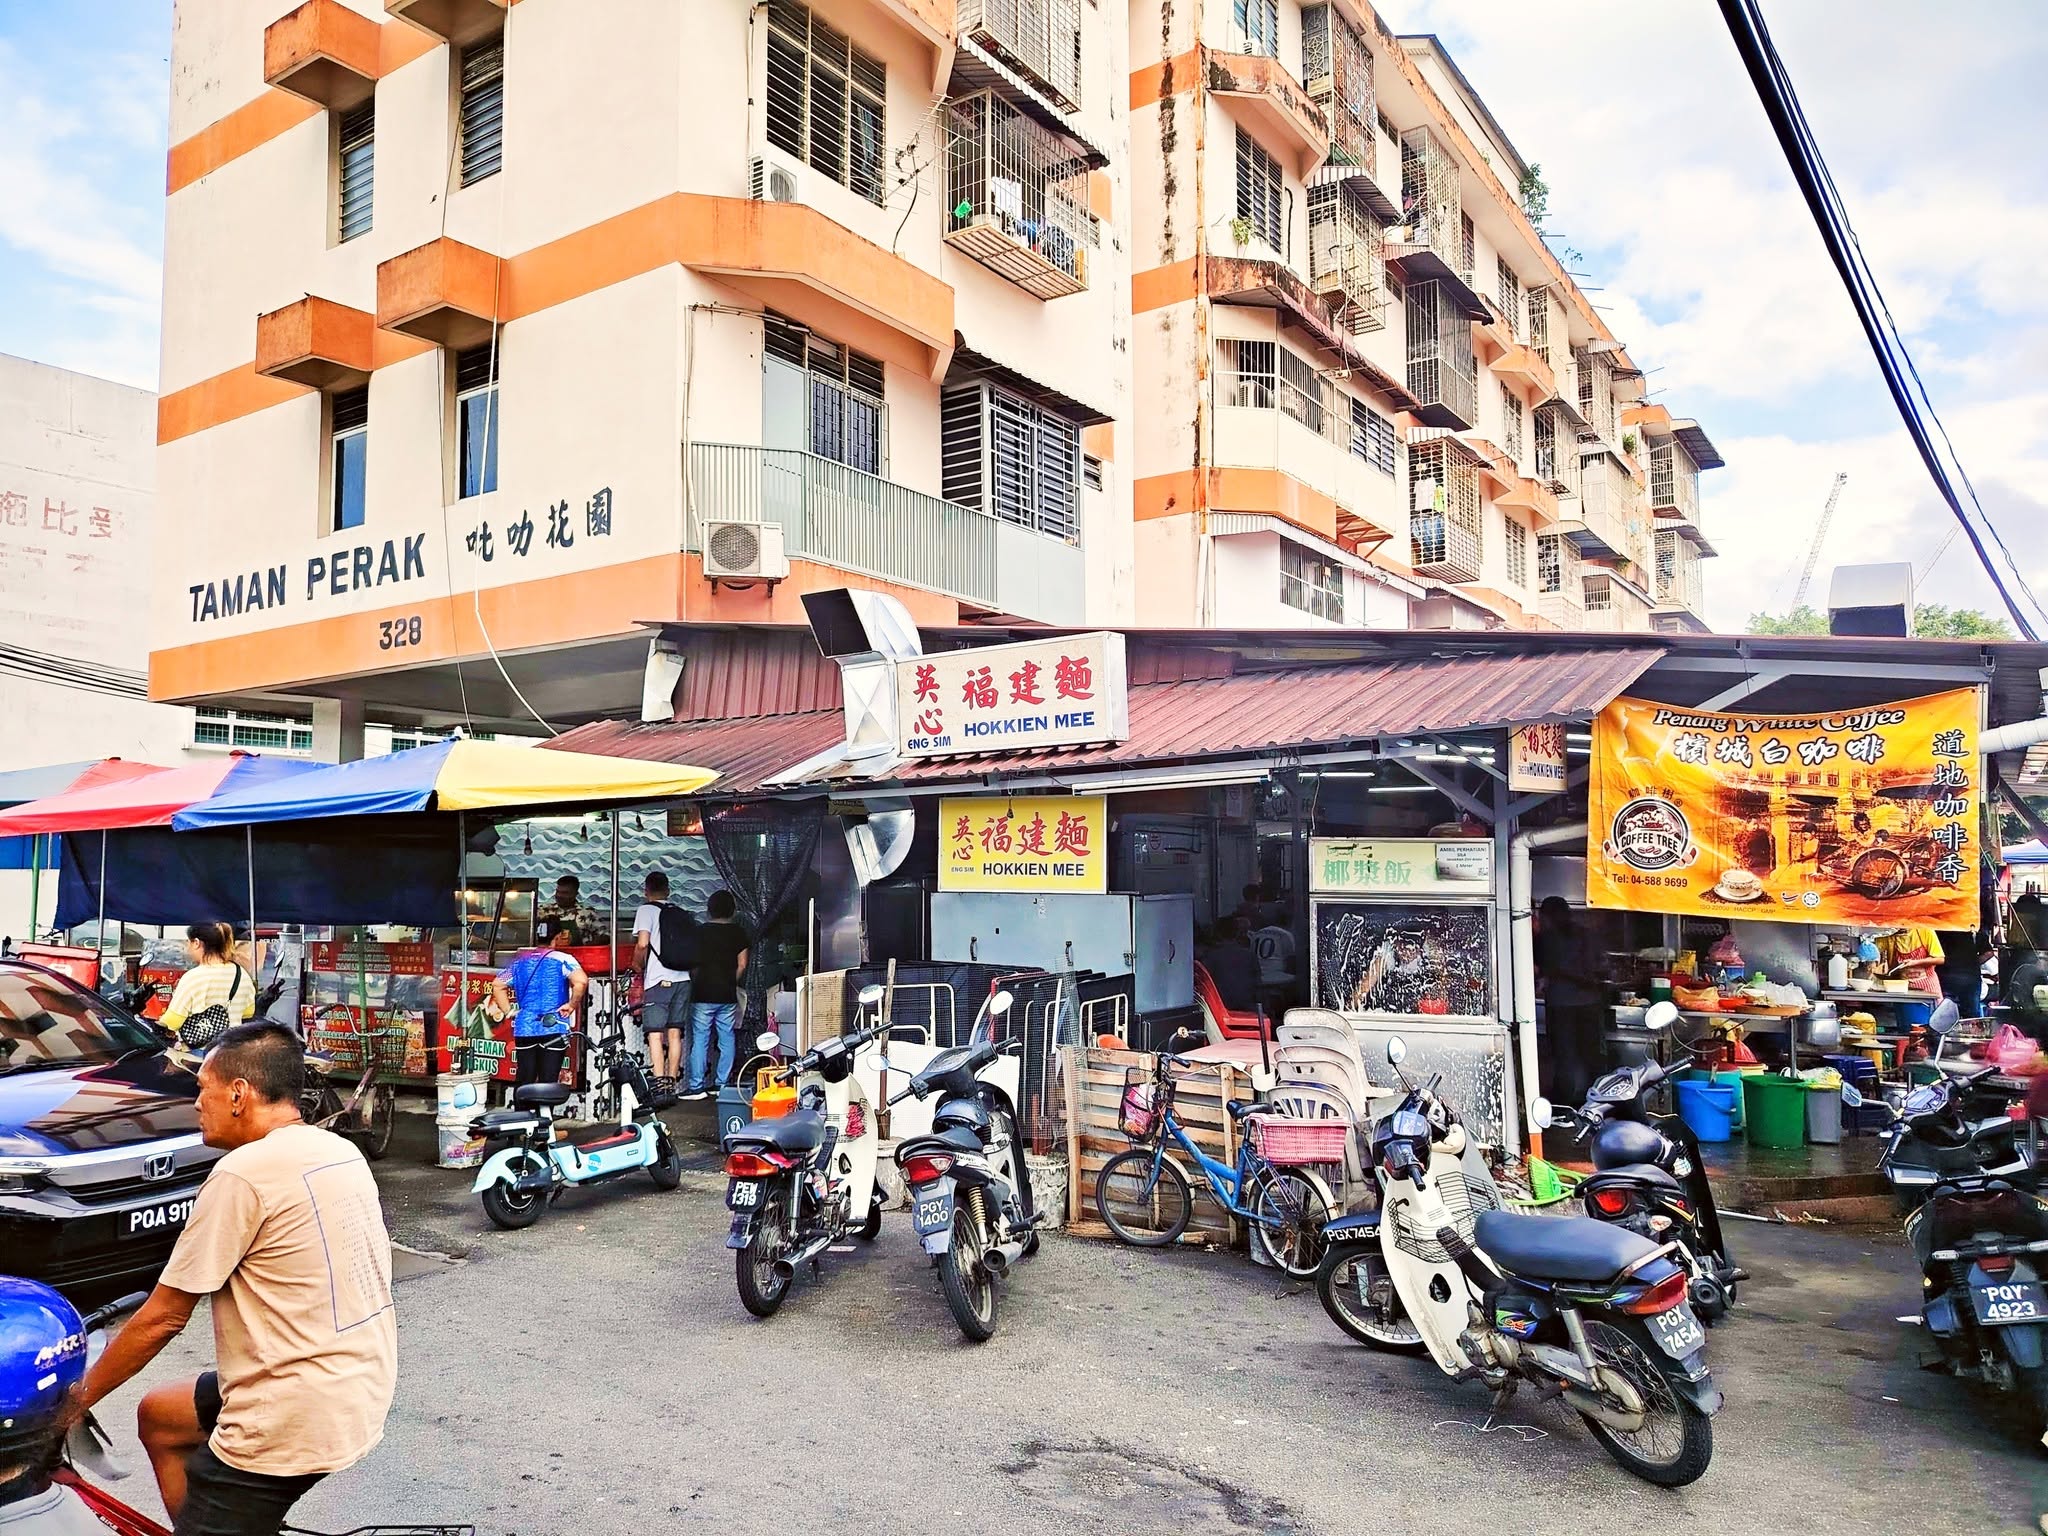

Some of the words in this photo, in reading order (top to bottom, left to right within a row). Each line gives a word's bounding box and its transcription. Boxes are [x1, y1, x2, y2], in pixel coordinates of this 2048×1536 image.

[189, 564, 286, 622] TAMAN
[307, 533, 425, 600] PERAK
[379, 616, 422, 650] 328
[962, 656, 1095, 710] 福建麵
[913, 663, 944, 735] 英心
[964, 716, 1048, 737] HOKKIEN
[1055, 711, 1095, 729] MEE
[1653, 709, 1729, 732] Penang
[907, 738, 929, 750] ENG
[933, 735, 952, 748] SIM
[1932, 729, 1970, 884] 道地咖啡香
[951, 815, 974, 861] 英心
[978, 811, 1091, 857] 福建麵
[1621, 833, 1653, 848] COFFEE
[1657, 835, 1678, 852] TREE
[983, 863, 1048, 876] HOKKIEN
[1053, 864, 1085, 876] MEE
[1612, 873, 1629, 883] Tel:
[1631, 875, 1662, 886] 04-588
[1664, 877, 1688, 887] 9699
[732, 1193, 756, 1206] 1319
[920, 1199, 943, 1216] PGY
[920, 1210, 948, 1227] 1400
[1987, 1285, 2022, 1302] PQY
[1656, 1305, 1686, 1332] PGX
[1988, 1301, 2035, 1317] 4923
[1664, 1321, 1701, 1352] 7454
